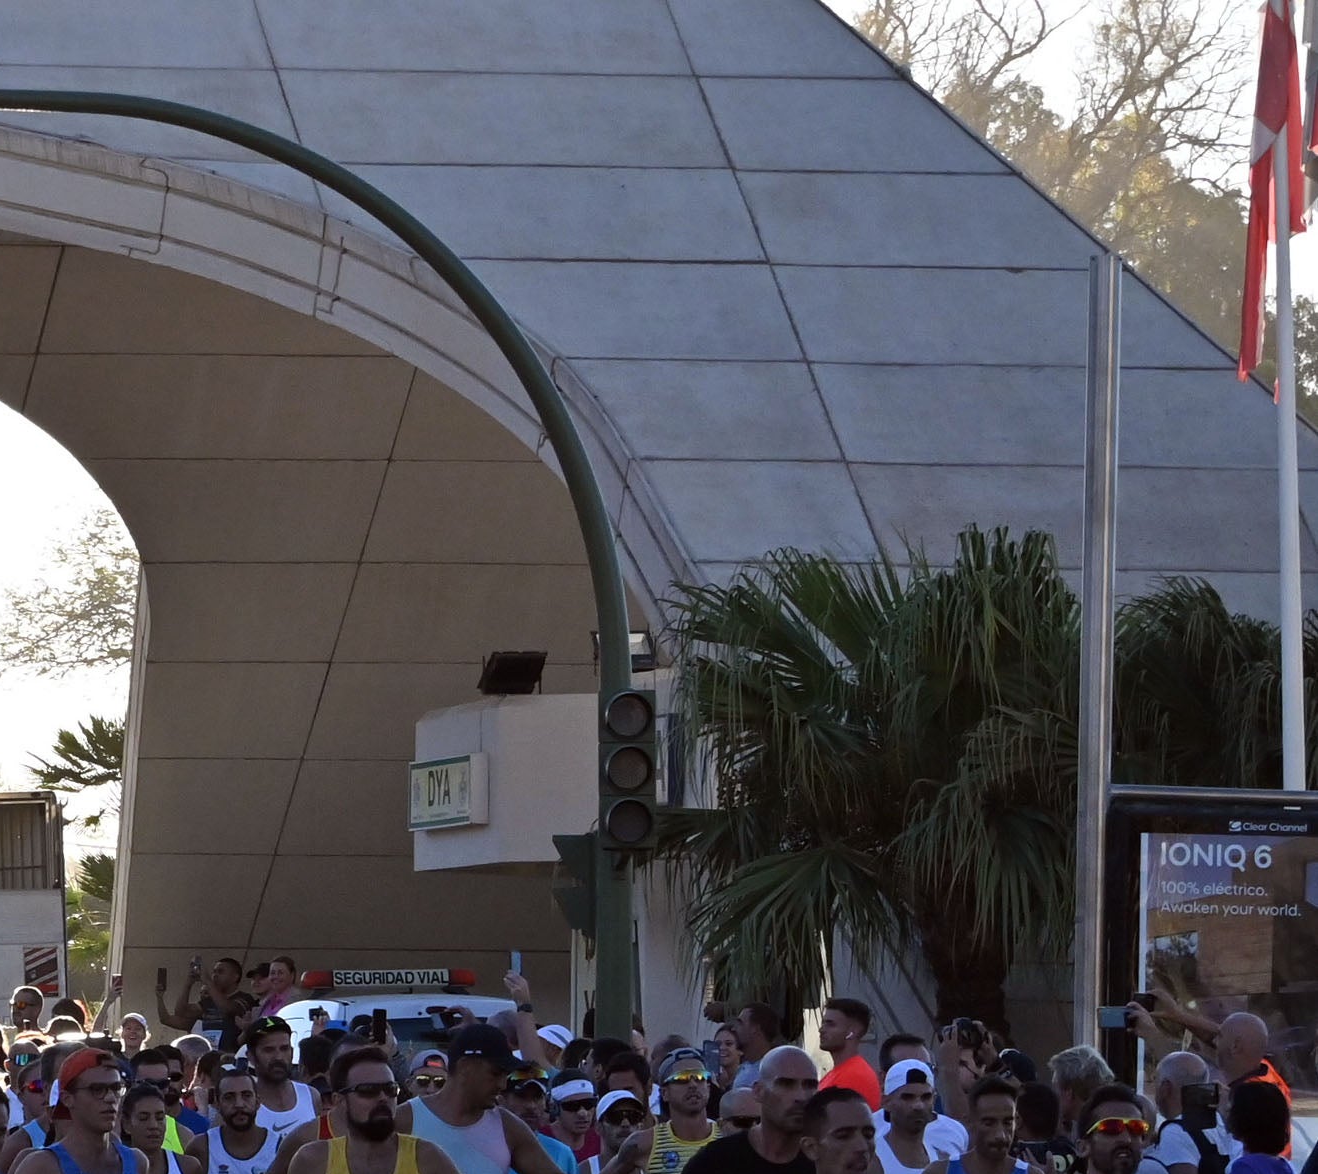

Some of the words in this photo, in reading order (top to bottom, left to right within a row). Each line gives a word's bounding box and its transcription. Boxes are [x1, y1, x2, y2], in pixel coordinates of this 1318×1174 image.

[428, 768, 451, 807] DYA
[1243, 822, 1267, 831] Clear
[1268, 822, 1308, 833] Channel
[1161, 841, 1246, 872] IONIQ
[1254, 844, 1272, 869] 6
[1161, 881, 1200, 895] 100%
[1203, 881, 1268, 896] eléctrico.
[1161, 902, 1219, 914] Awaken
[1222, 904, 1254, 917] your
[1257, 904, 1302, 917] world.
[334, 971, 414, 985] SEGURIDAD
[417, 971, 450, 985] VIAL
